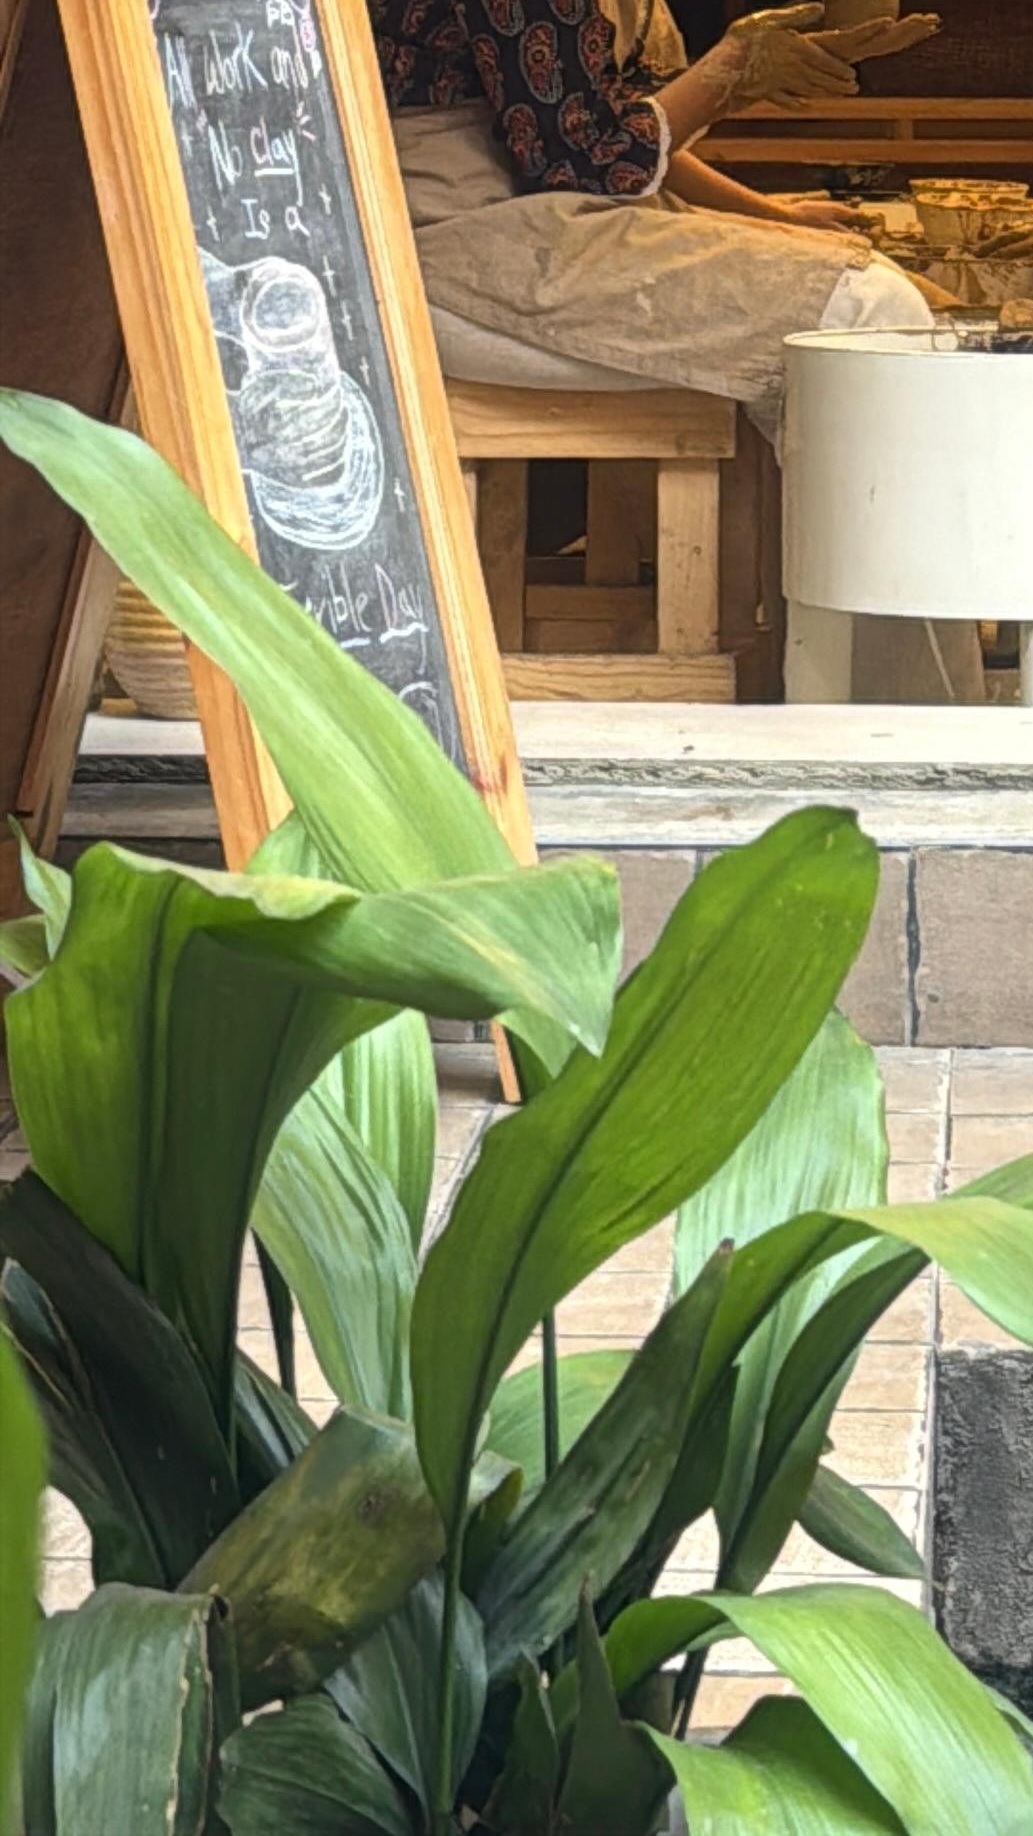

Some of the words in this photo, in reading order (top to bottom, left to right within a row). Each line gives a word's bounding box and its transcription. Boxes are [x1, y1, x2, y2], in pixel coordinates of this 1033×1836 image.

[208, 119, 243, 192] No
[240, 198, 271, 240] Is
[284, 205, 312, 237] a
[375, 563, 427, 674] Day
